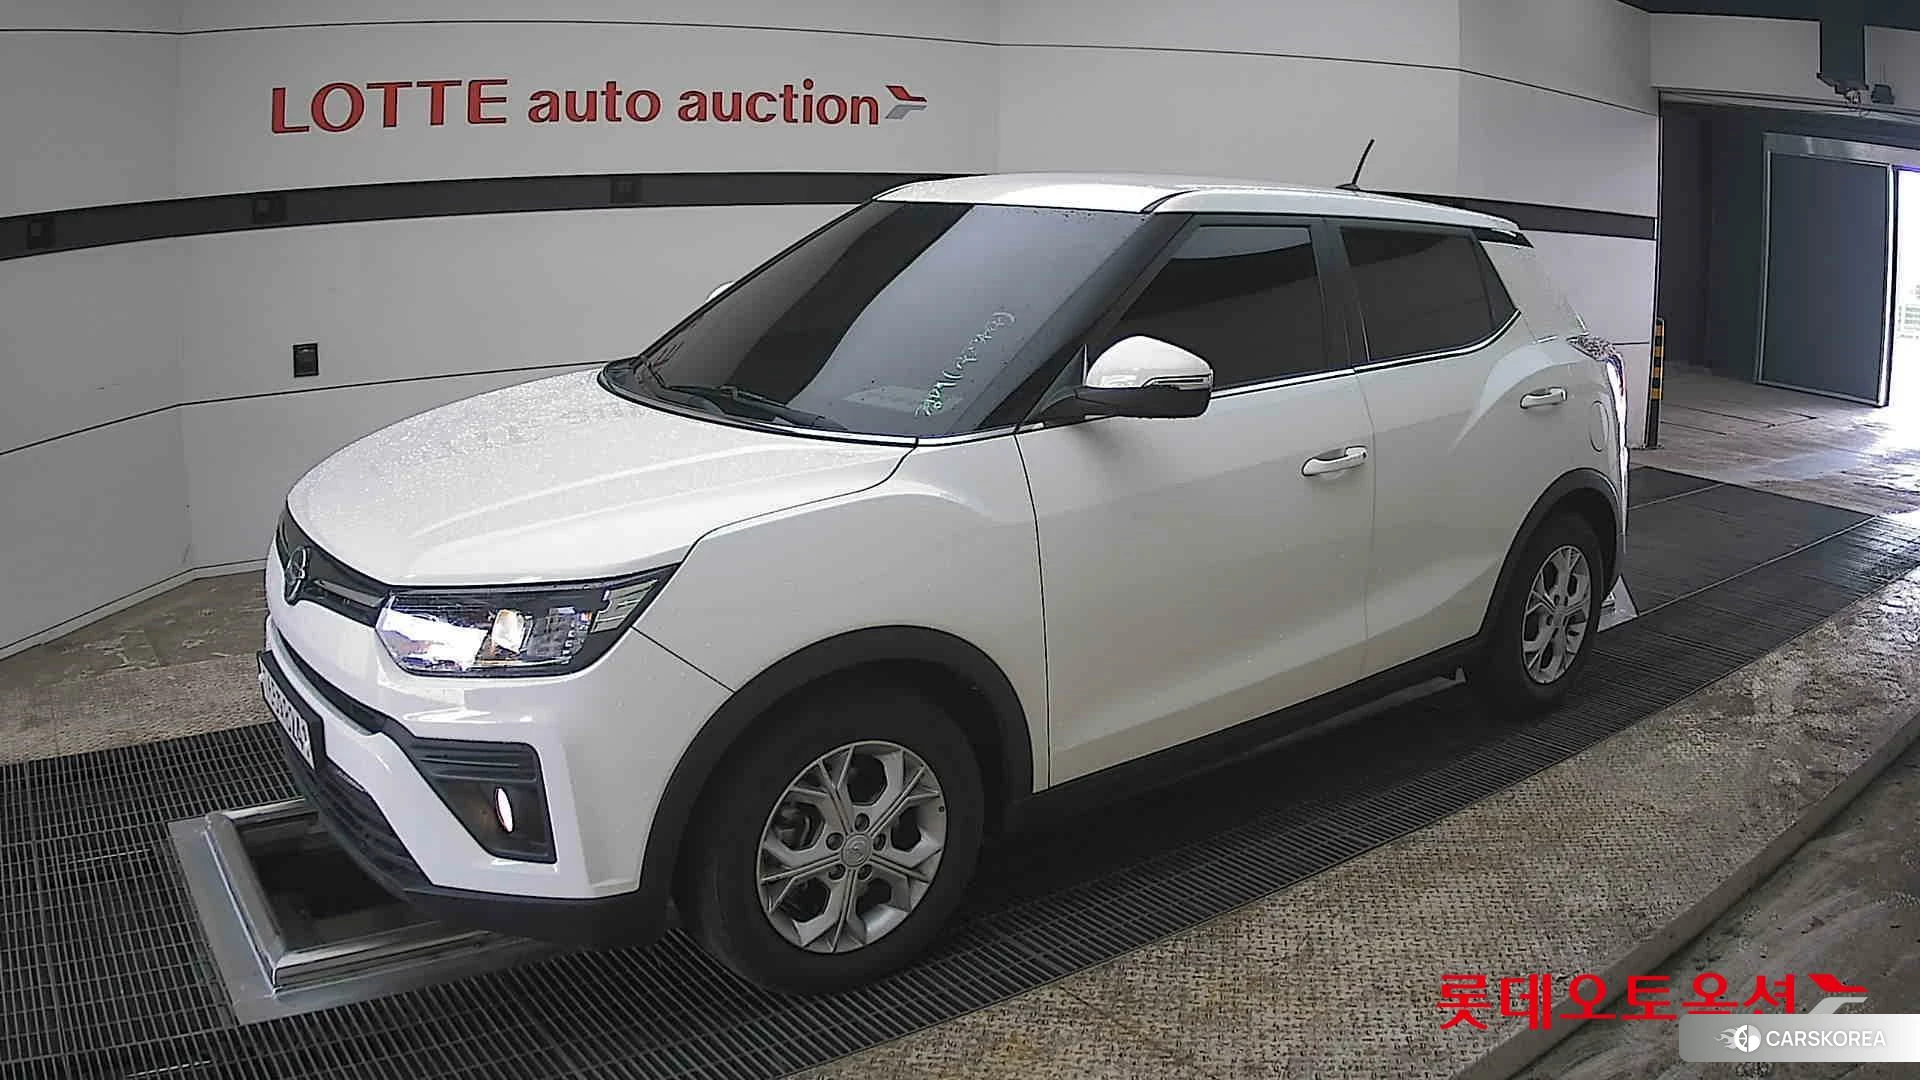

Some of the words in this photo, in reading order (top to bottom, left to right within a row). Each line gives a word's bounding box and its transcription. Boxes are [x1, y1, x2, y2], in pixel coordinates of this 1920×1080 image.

[271, 79, 508, 133] LOTTE
[528, 81, 662, 124] auto
[678, 80, 880, 125] auction
